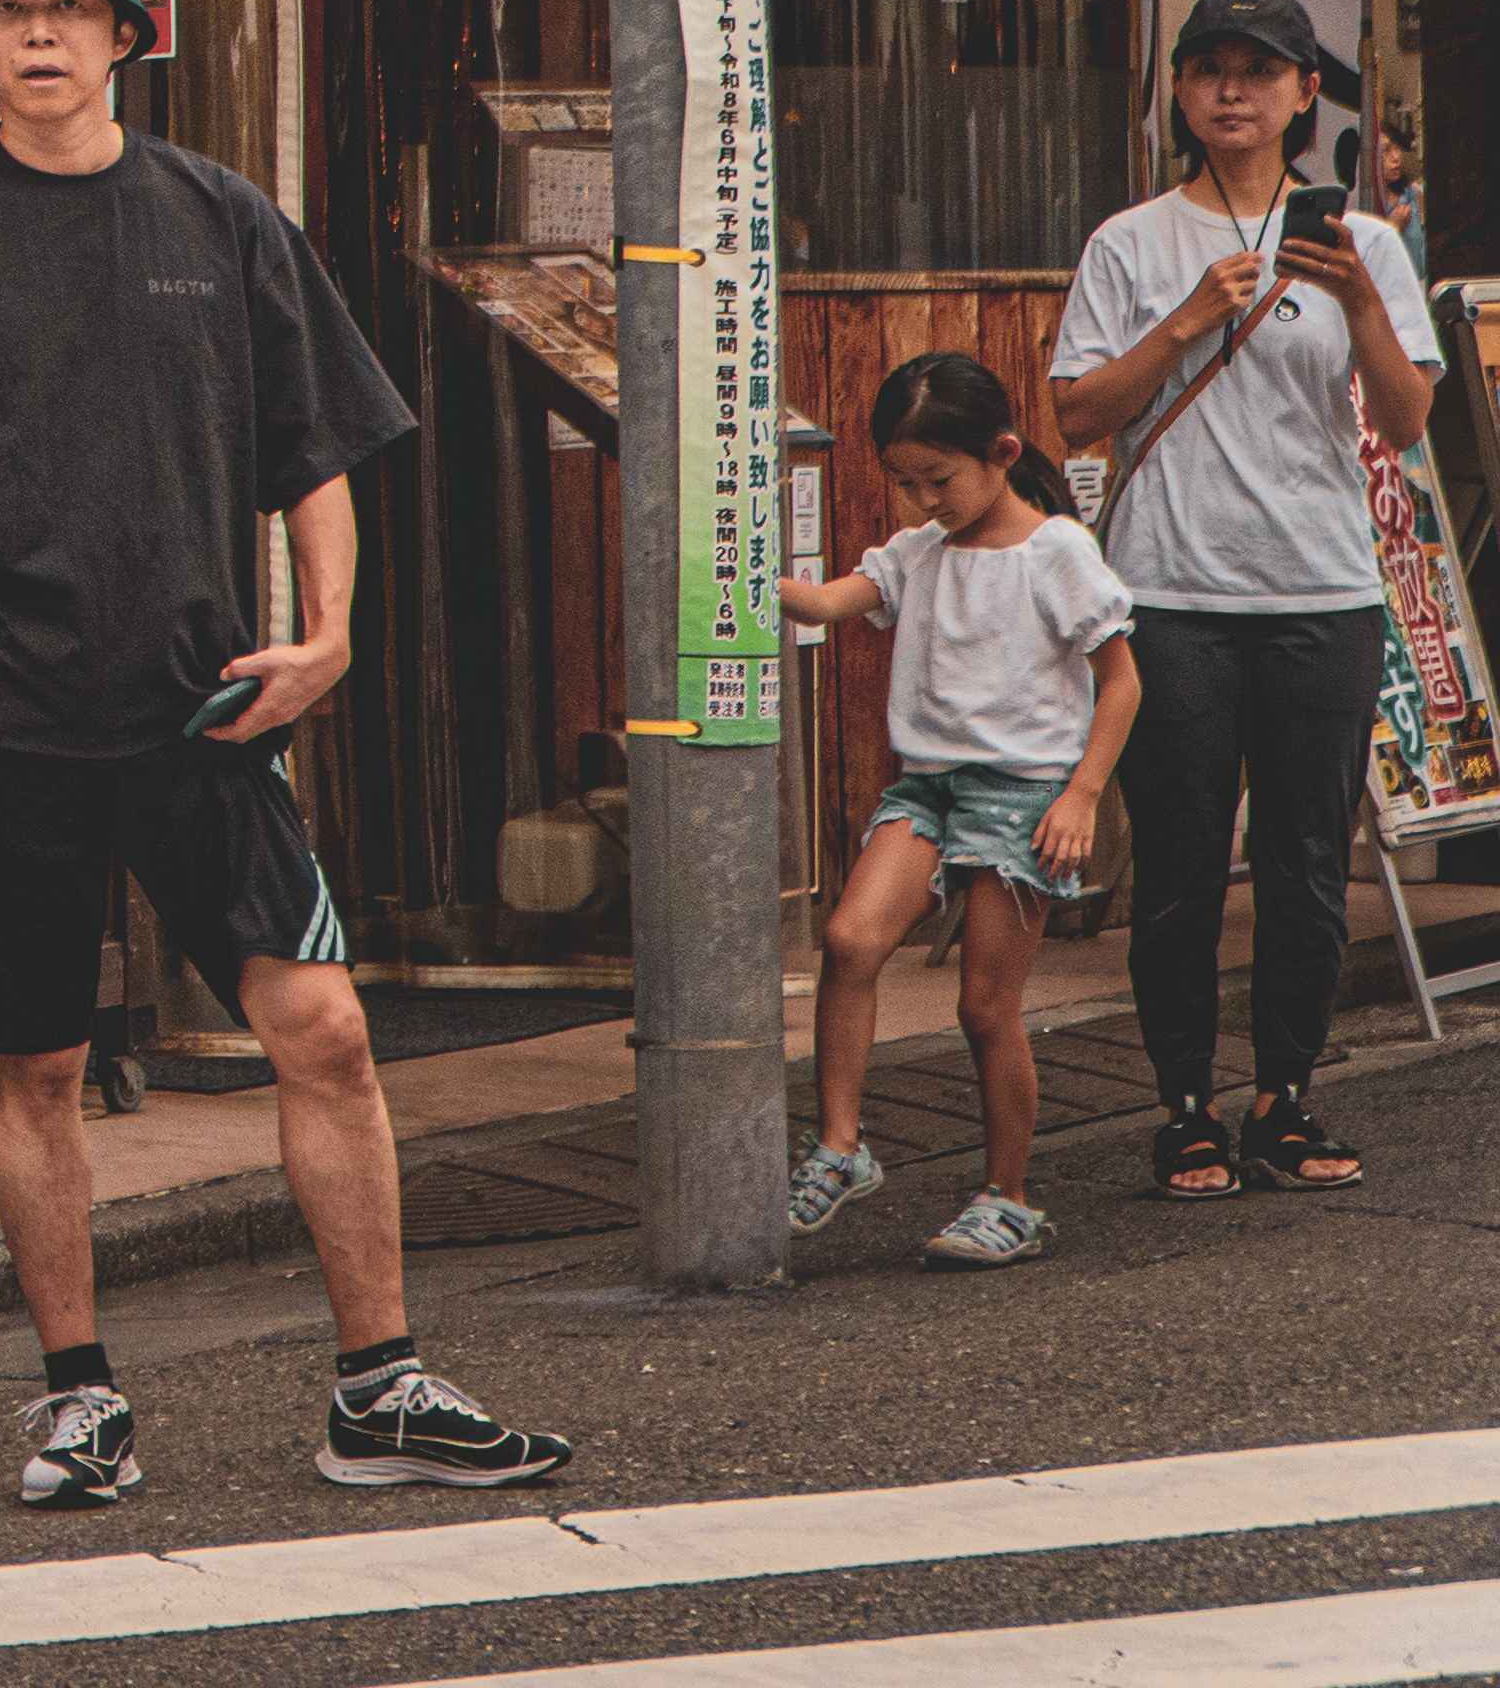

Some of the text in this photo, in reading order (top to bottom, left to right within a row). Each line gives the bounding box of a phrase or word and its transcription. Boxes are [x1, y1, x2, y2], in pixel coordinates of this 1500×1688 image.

[714, 278, 739, 355] 施工時間
[1350, 372, 1455, 705] み放題
